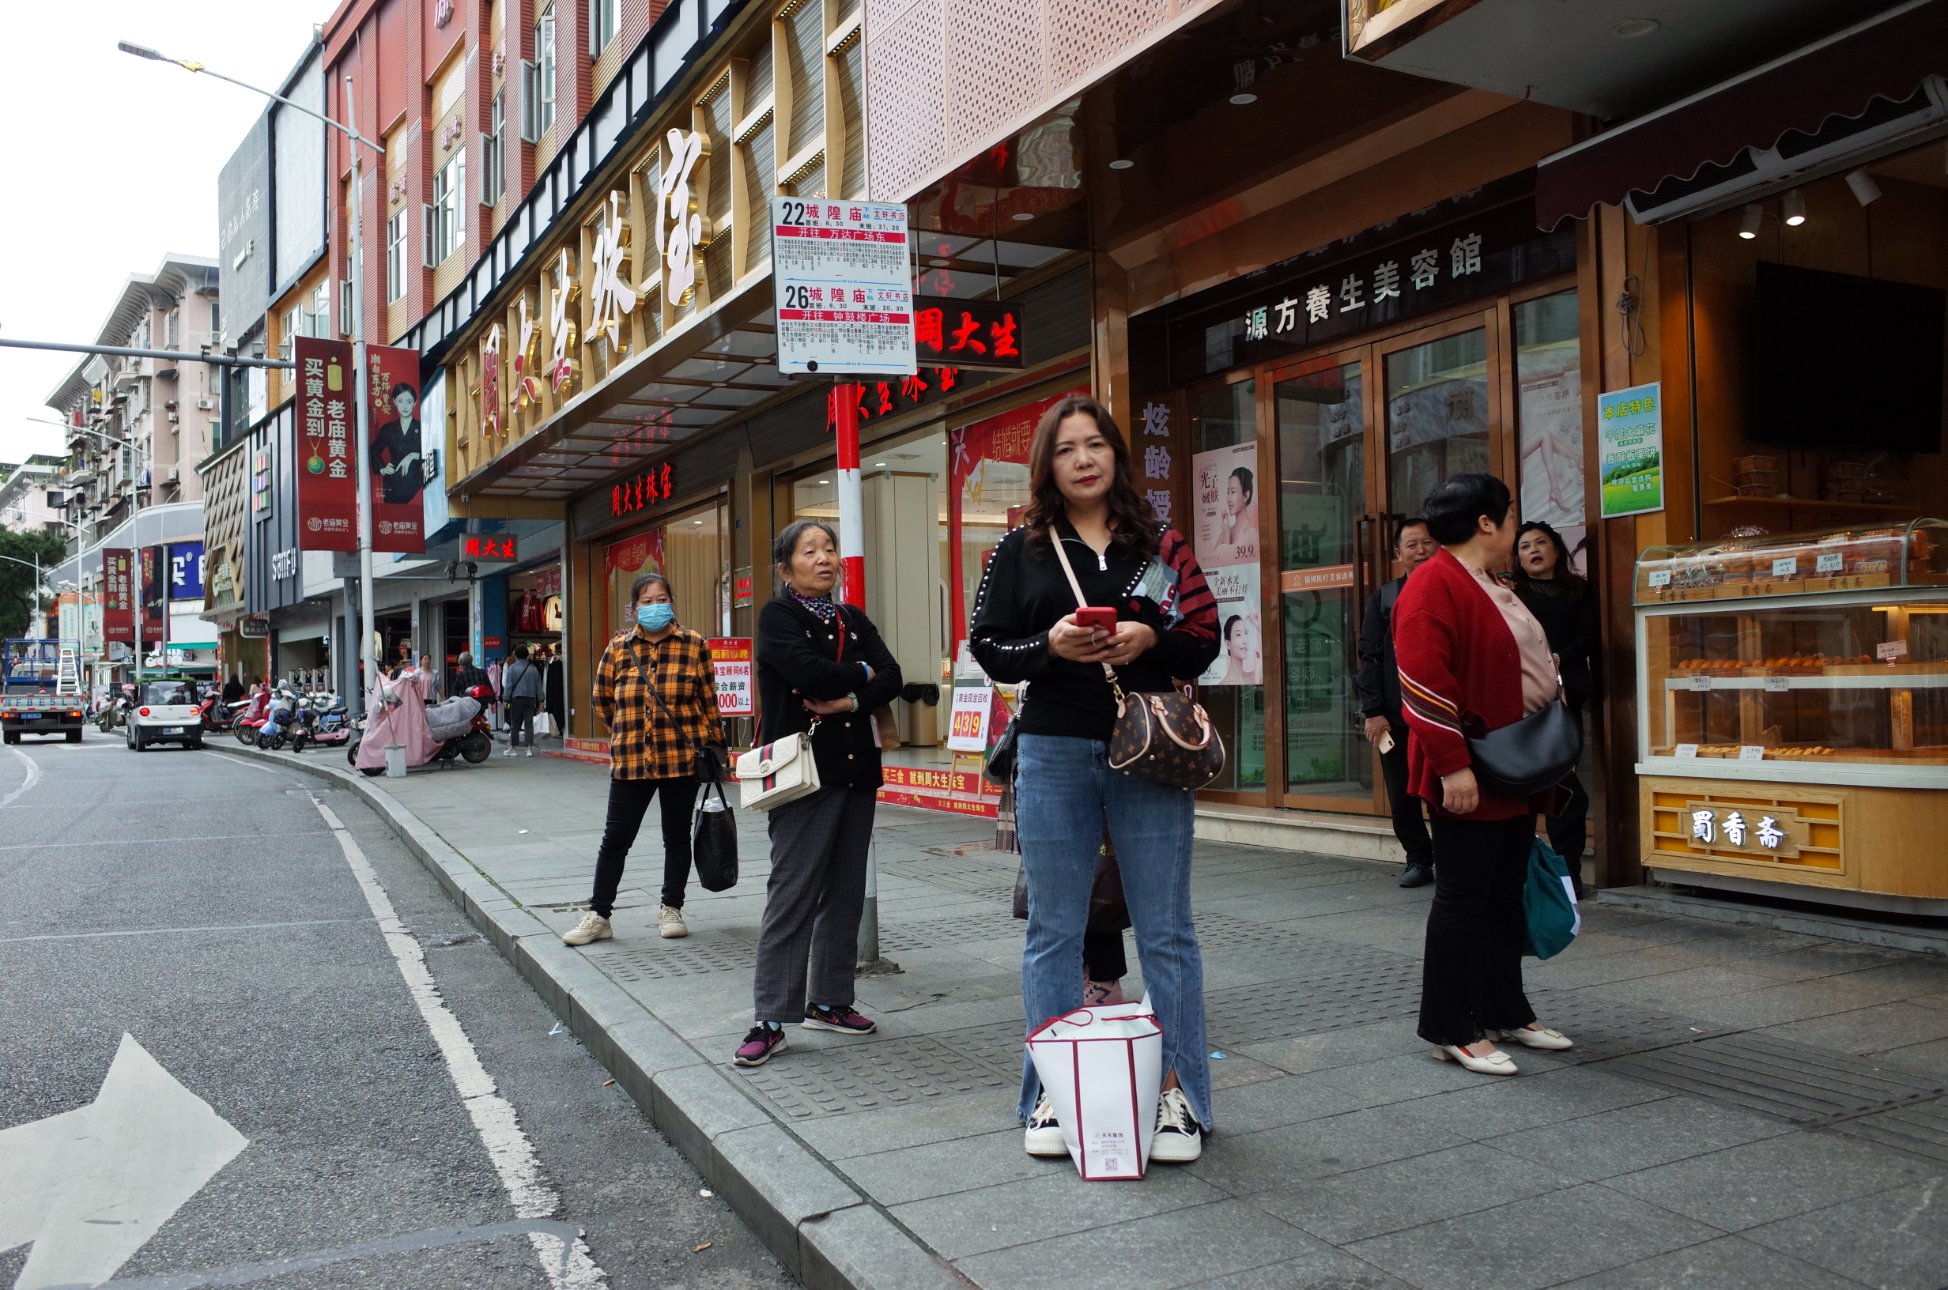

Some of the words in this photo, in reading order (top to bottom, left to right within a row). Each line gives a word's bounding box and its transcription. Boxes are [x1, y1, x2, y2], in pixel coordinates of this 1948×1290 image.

[782, 202, 805, 226] 22
[805, 203, 862, 221] 城隍庙
[799, 228, 820, 237] 开往
[829, 229, 886, 242] 万达广场东
[785, 285, 809, 309] 26
[808, 286, 866, 303] 城隍庙
[877, 292, 909, 300] 文轩书店
[1245, 232, 1483, 342] 源方養生美容館
[802, 310, 824, 321] 开往
[833, 312, 890, 323] 钟鼓楼广场
[914, 307, 1020, 357] 周大生
[304, 357, 325, 438] 买黄金到
[1603, 397, 1656, 420] 本店特色
[326, 399, 348, 478] 老庙黄金
[611, 462, 673, 517] 周大生珠宝
[464, 537, 515, 558] 周大生
[1234, 545, 1253, 560] 39.9
[954, 714, 980, 734] 439
[883, 768, 905, 784] 买三金
[1691, 810, 1784, 849] 蜀香斋
